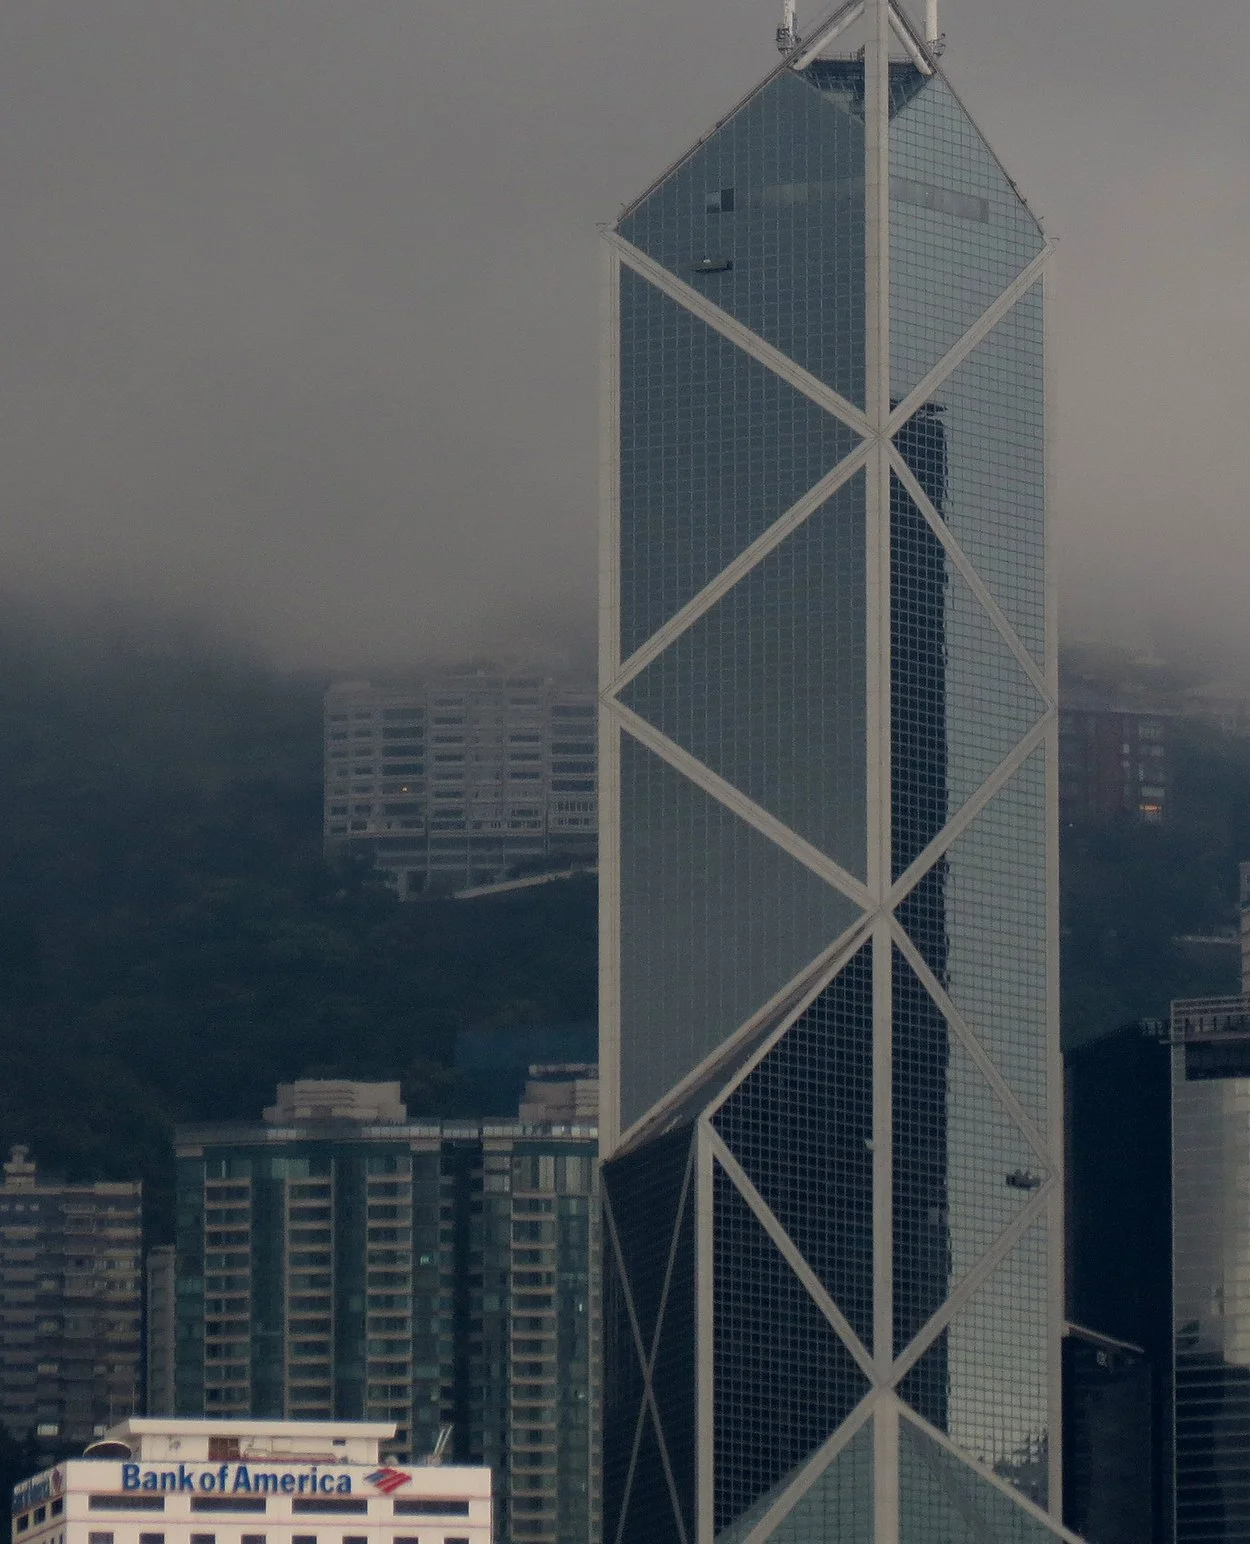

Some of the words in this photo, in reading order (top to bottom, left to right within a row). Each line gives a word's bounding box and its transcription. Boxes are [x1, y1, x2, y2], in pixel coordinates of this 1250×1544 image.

[122, 1463, 194, 1492] Bank
[199, 1464, 229, 1493] of
[232, 1465, 352, 1494] America
